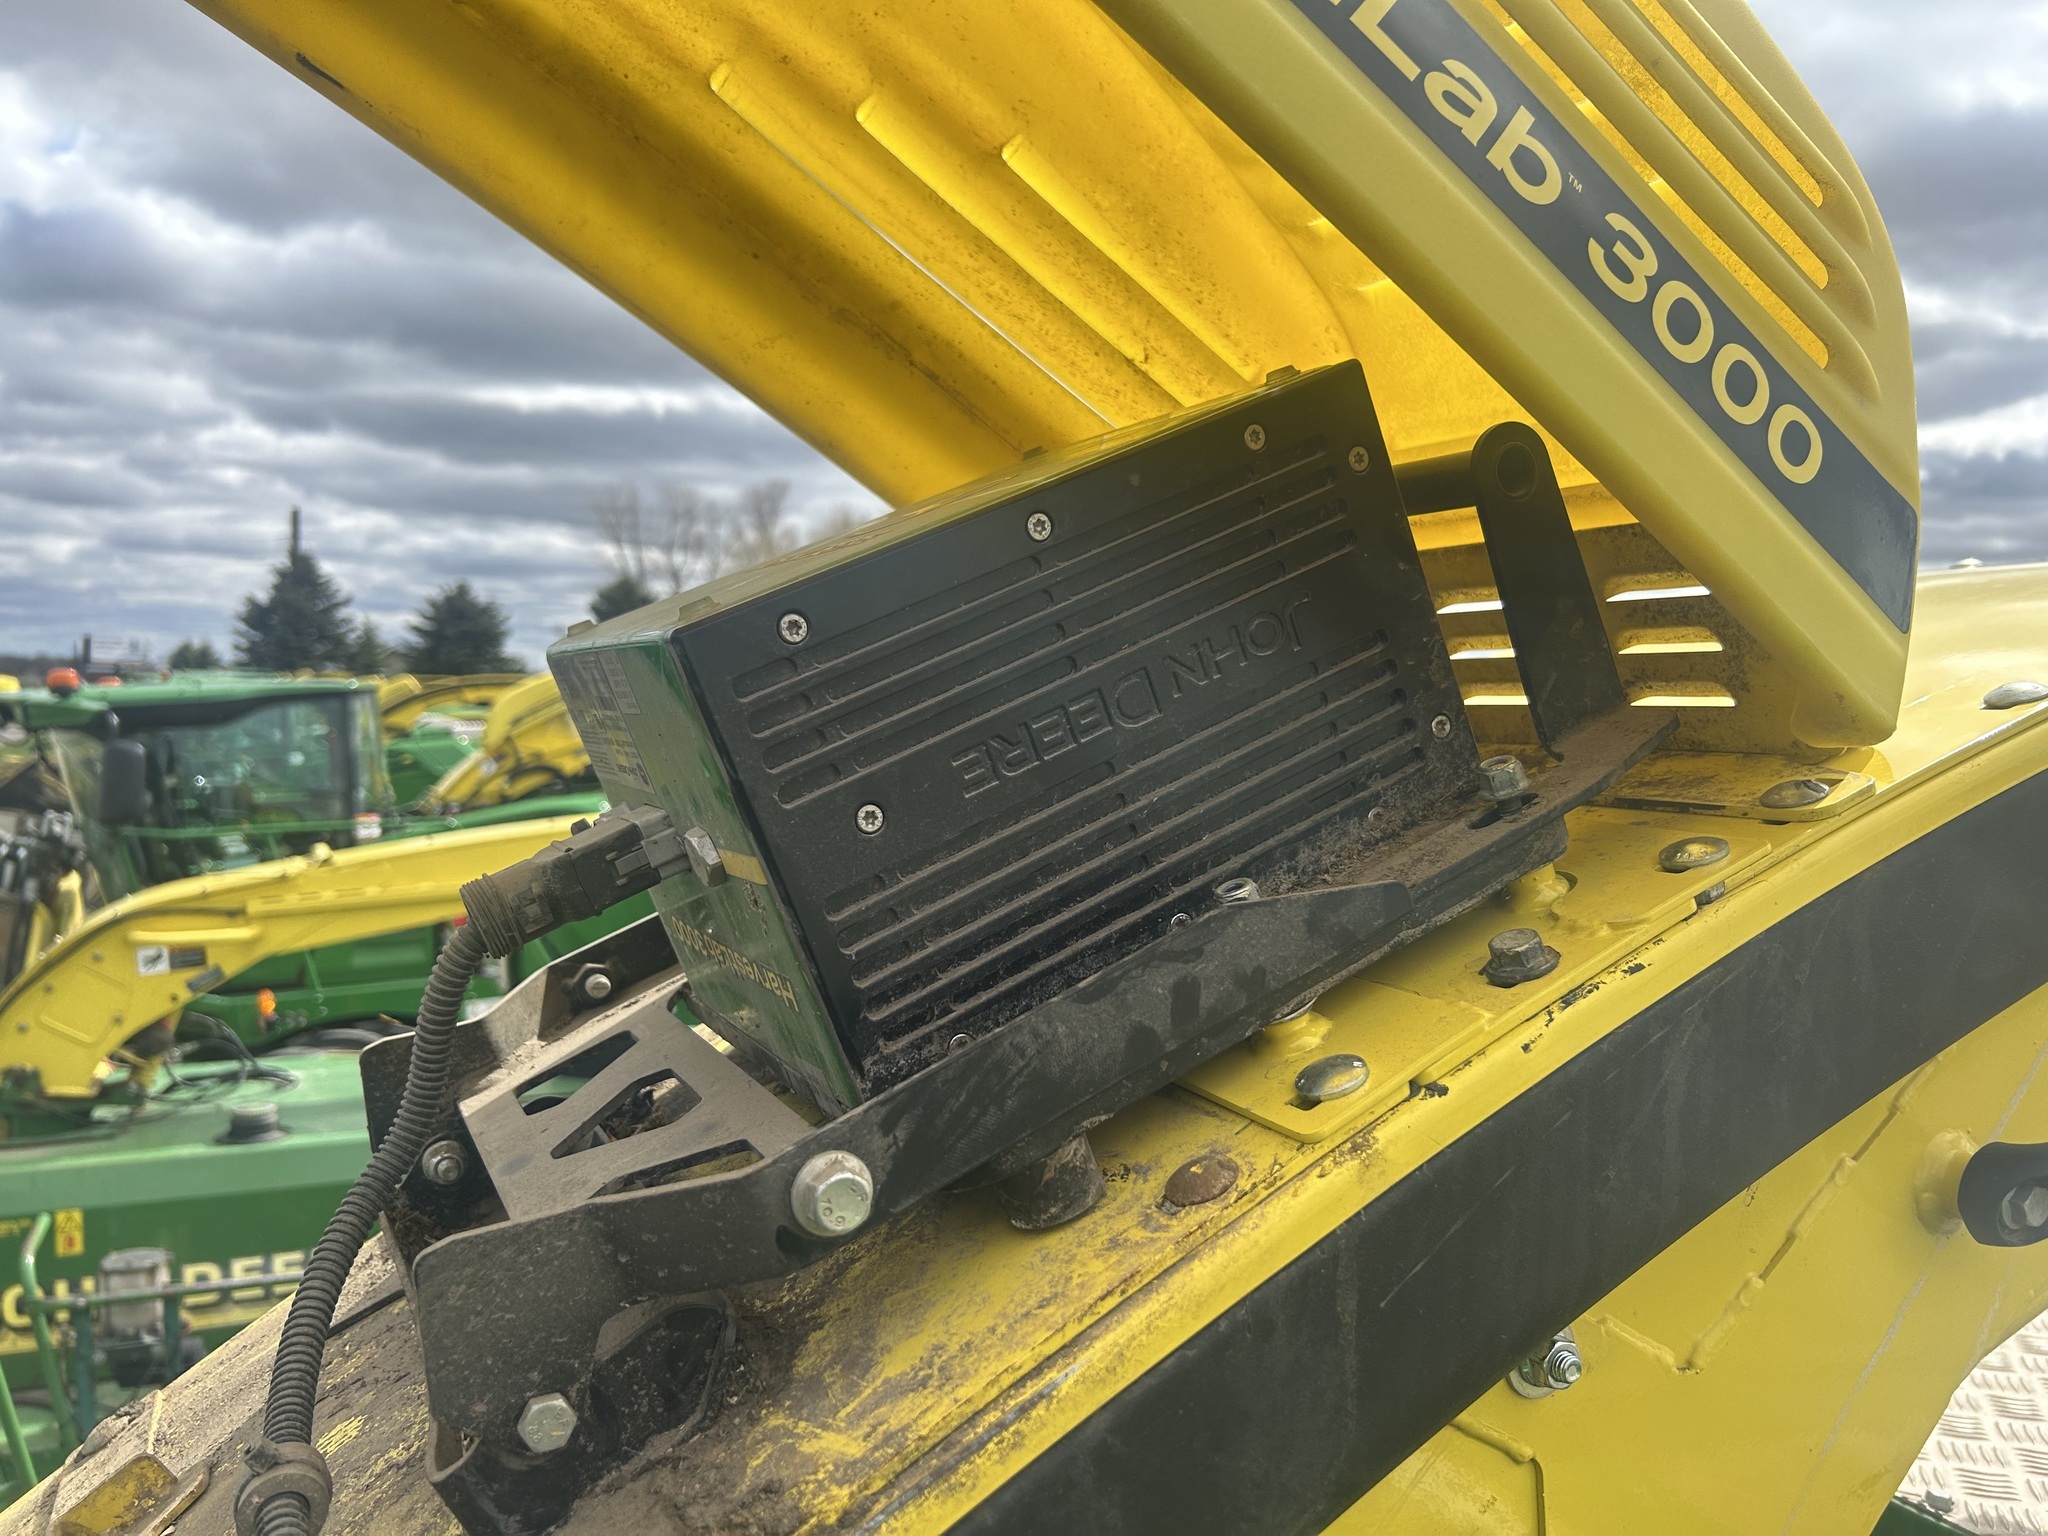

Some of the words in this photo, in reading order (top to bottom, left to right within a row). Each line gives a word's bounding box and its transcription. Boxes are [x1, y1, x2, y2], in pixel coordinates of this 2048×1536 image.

[1329, 0, 1563, 205] Lab
[1587, 212, 1823, 484] 3000
[1163, 591, 1312, 698] JOHN
[951, 667, 1164, 799] DEERE
[671, 915, 708, 956] 3000
[704, 934, 799, 1013] HarvestLab
